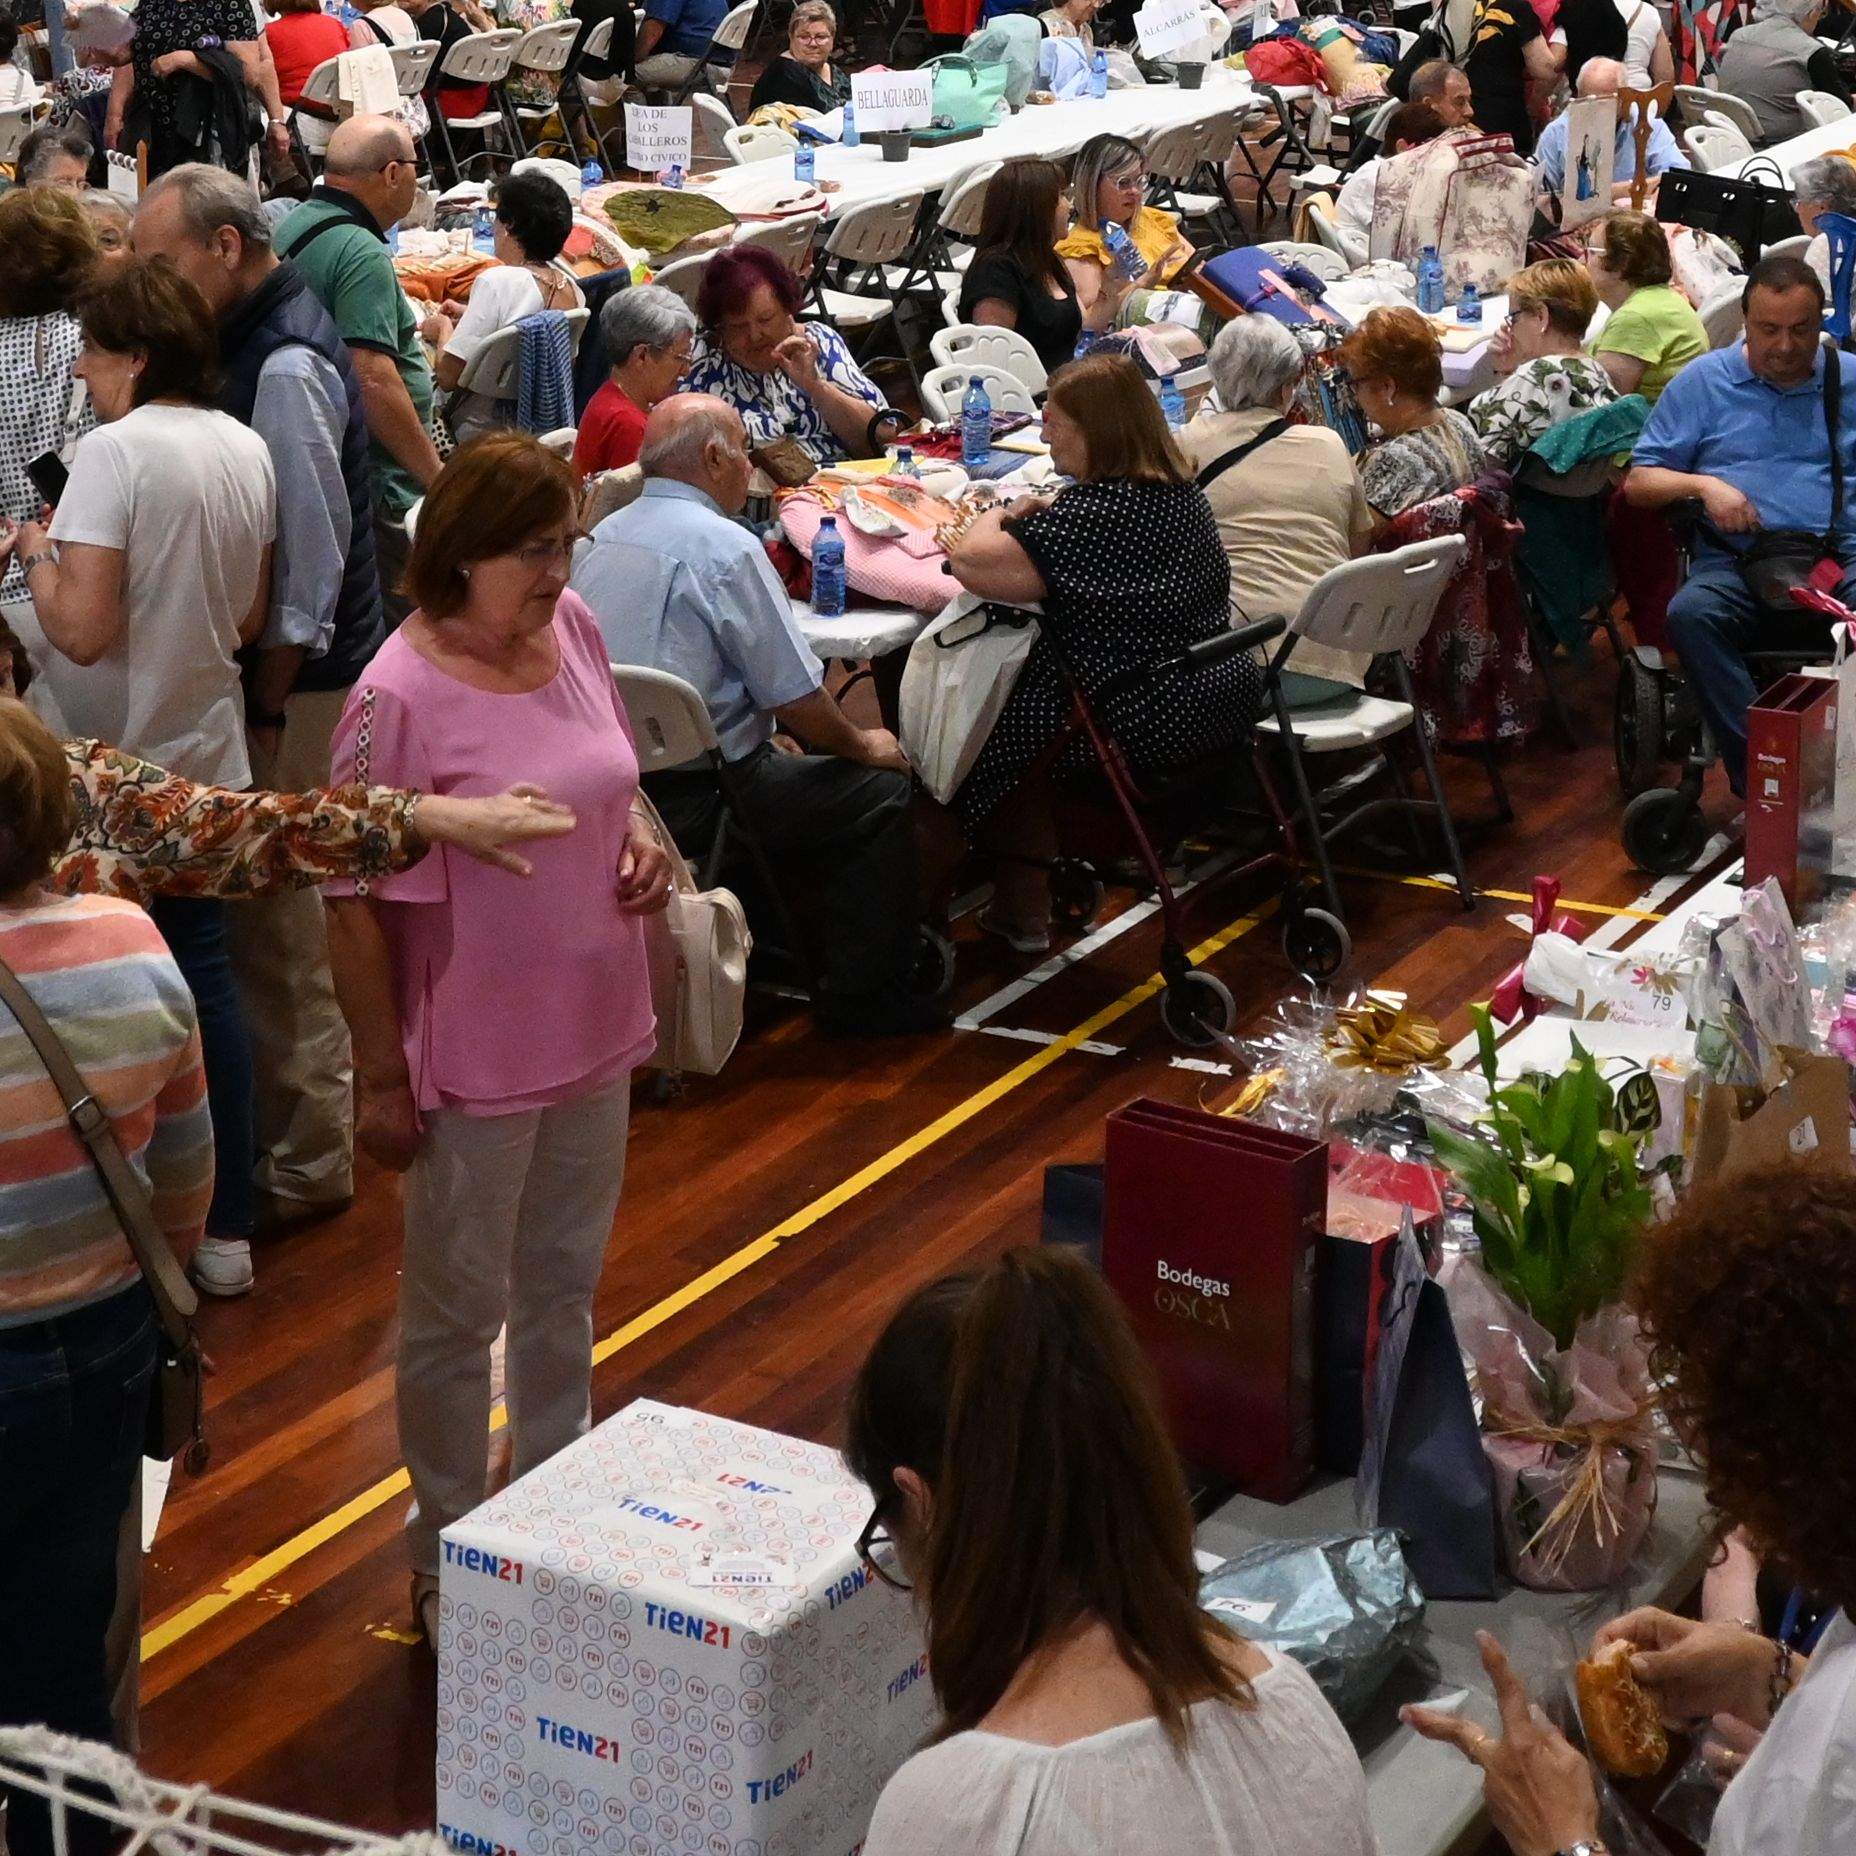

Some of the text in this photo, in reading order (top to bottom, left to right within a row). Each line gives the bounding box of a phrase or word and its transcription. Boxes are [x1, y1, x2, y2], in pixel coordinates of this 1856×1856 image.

[1143, 9, 1196, 37] ALCARRÁS
[857, 88, 929, 110] BELLAGUARDA
[651, 109, 668, 119] DE
[638, 122, 658, 133] LOS
[1652, 994, 1672, 1011] 79
[1157, 1259, 1231, 1297] Bodegas
[1153, 1287, 1232, 1331] OSCA
[824, 1560, 874, 1611] TieN2
[589, 1593, 602, 1603] T21
[487, 1619, 498, 1629] T21
[613, 1630, 627, 1641] T21
[510, 1656, 523, 1665] T21
[588, 1652, 601, 1662] T21
[486, 1676, 499, 1686] T21
[612, 1689, 625, 1699] T21
[691, 1685, 704, 1694] T21
[510, 1713, 522, 1722] T21
[717, 1722, 729, 1732] T21
[486, 1733, 499, 1742] T21
[689, 1744, 702, 1754] T21
[508, 1771, 521, 1780] T21
[715, 1782, 727, 1791] T21
[484, 1791, 495, 1799] T21
[609, 1805, 623, 1815] T21
[687, 1803, 700, 1814] T21
[583, 1827, 596, 1836] T21
[713, 1841, 726, 1850] T21
